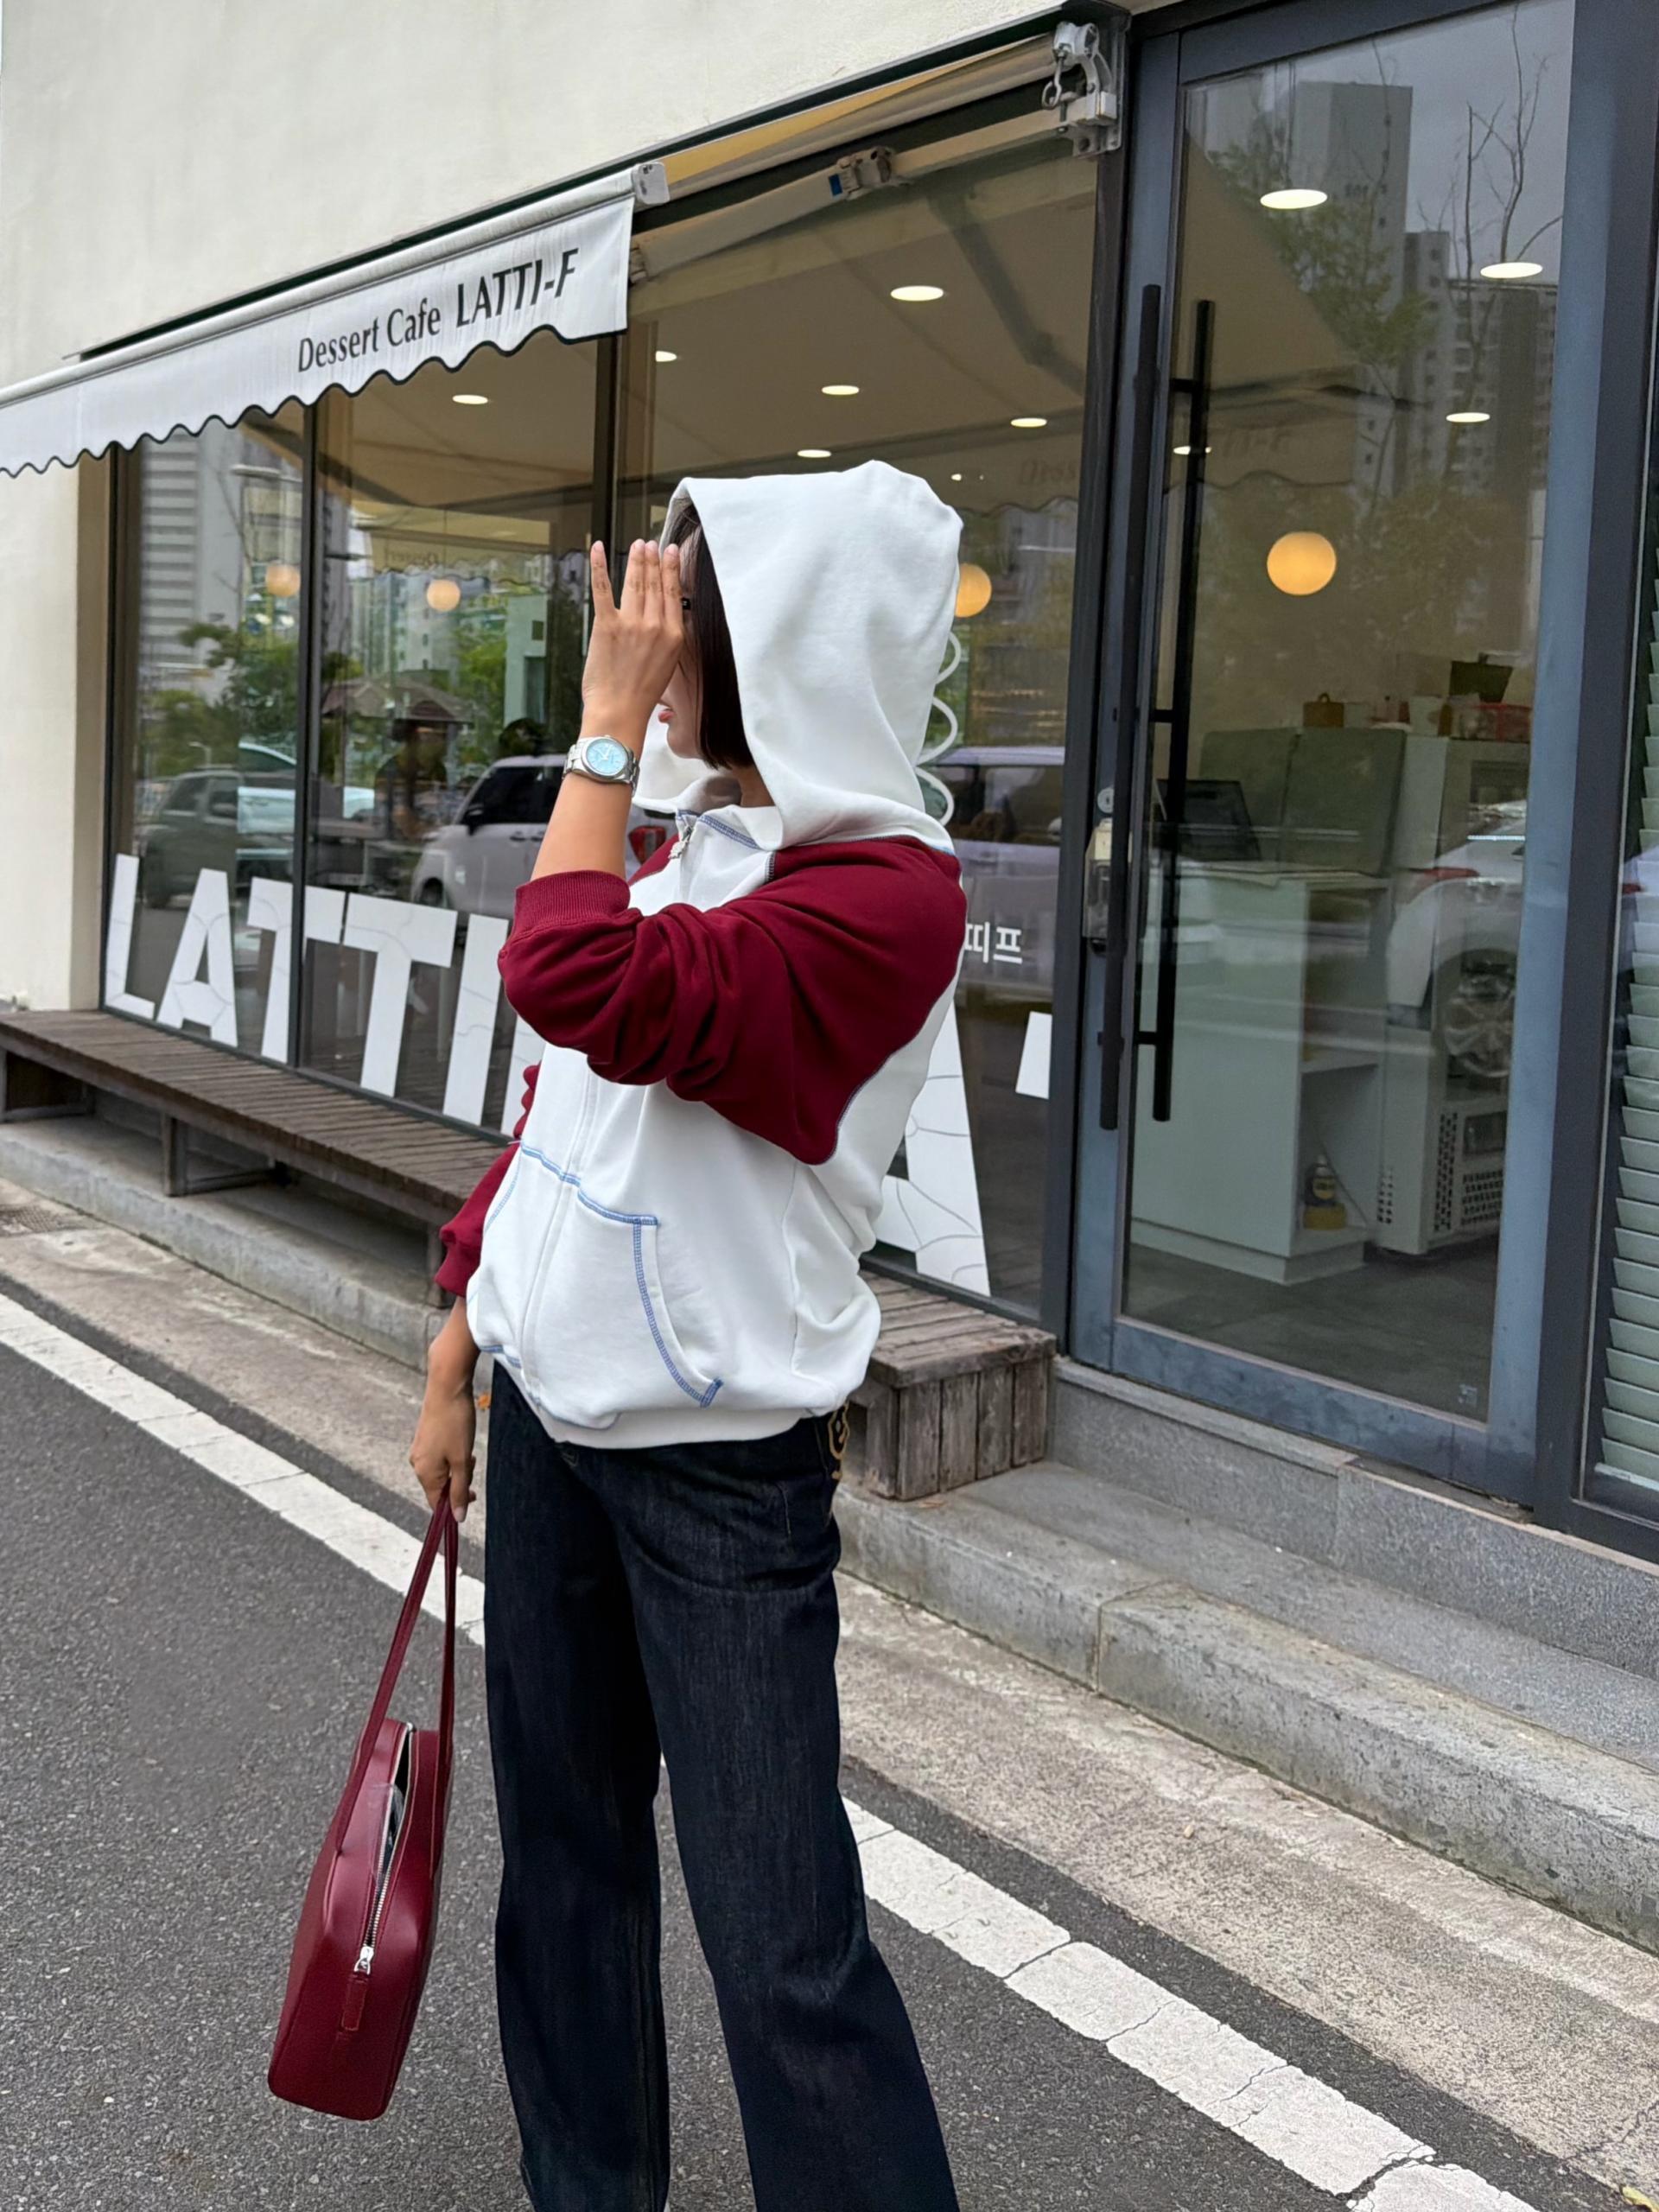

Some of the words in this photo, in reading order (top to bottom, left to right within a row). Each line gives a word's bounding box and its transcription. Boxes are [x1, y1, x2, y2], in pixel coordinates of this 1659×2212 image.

[298, 316, 380, 372] Dessert
[386, 297, 442, 346] Cafe
[456, 248, 579, 327] LATTI-F
